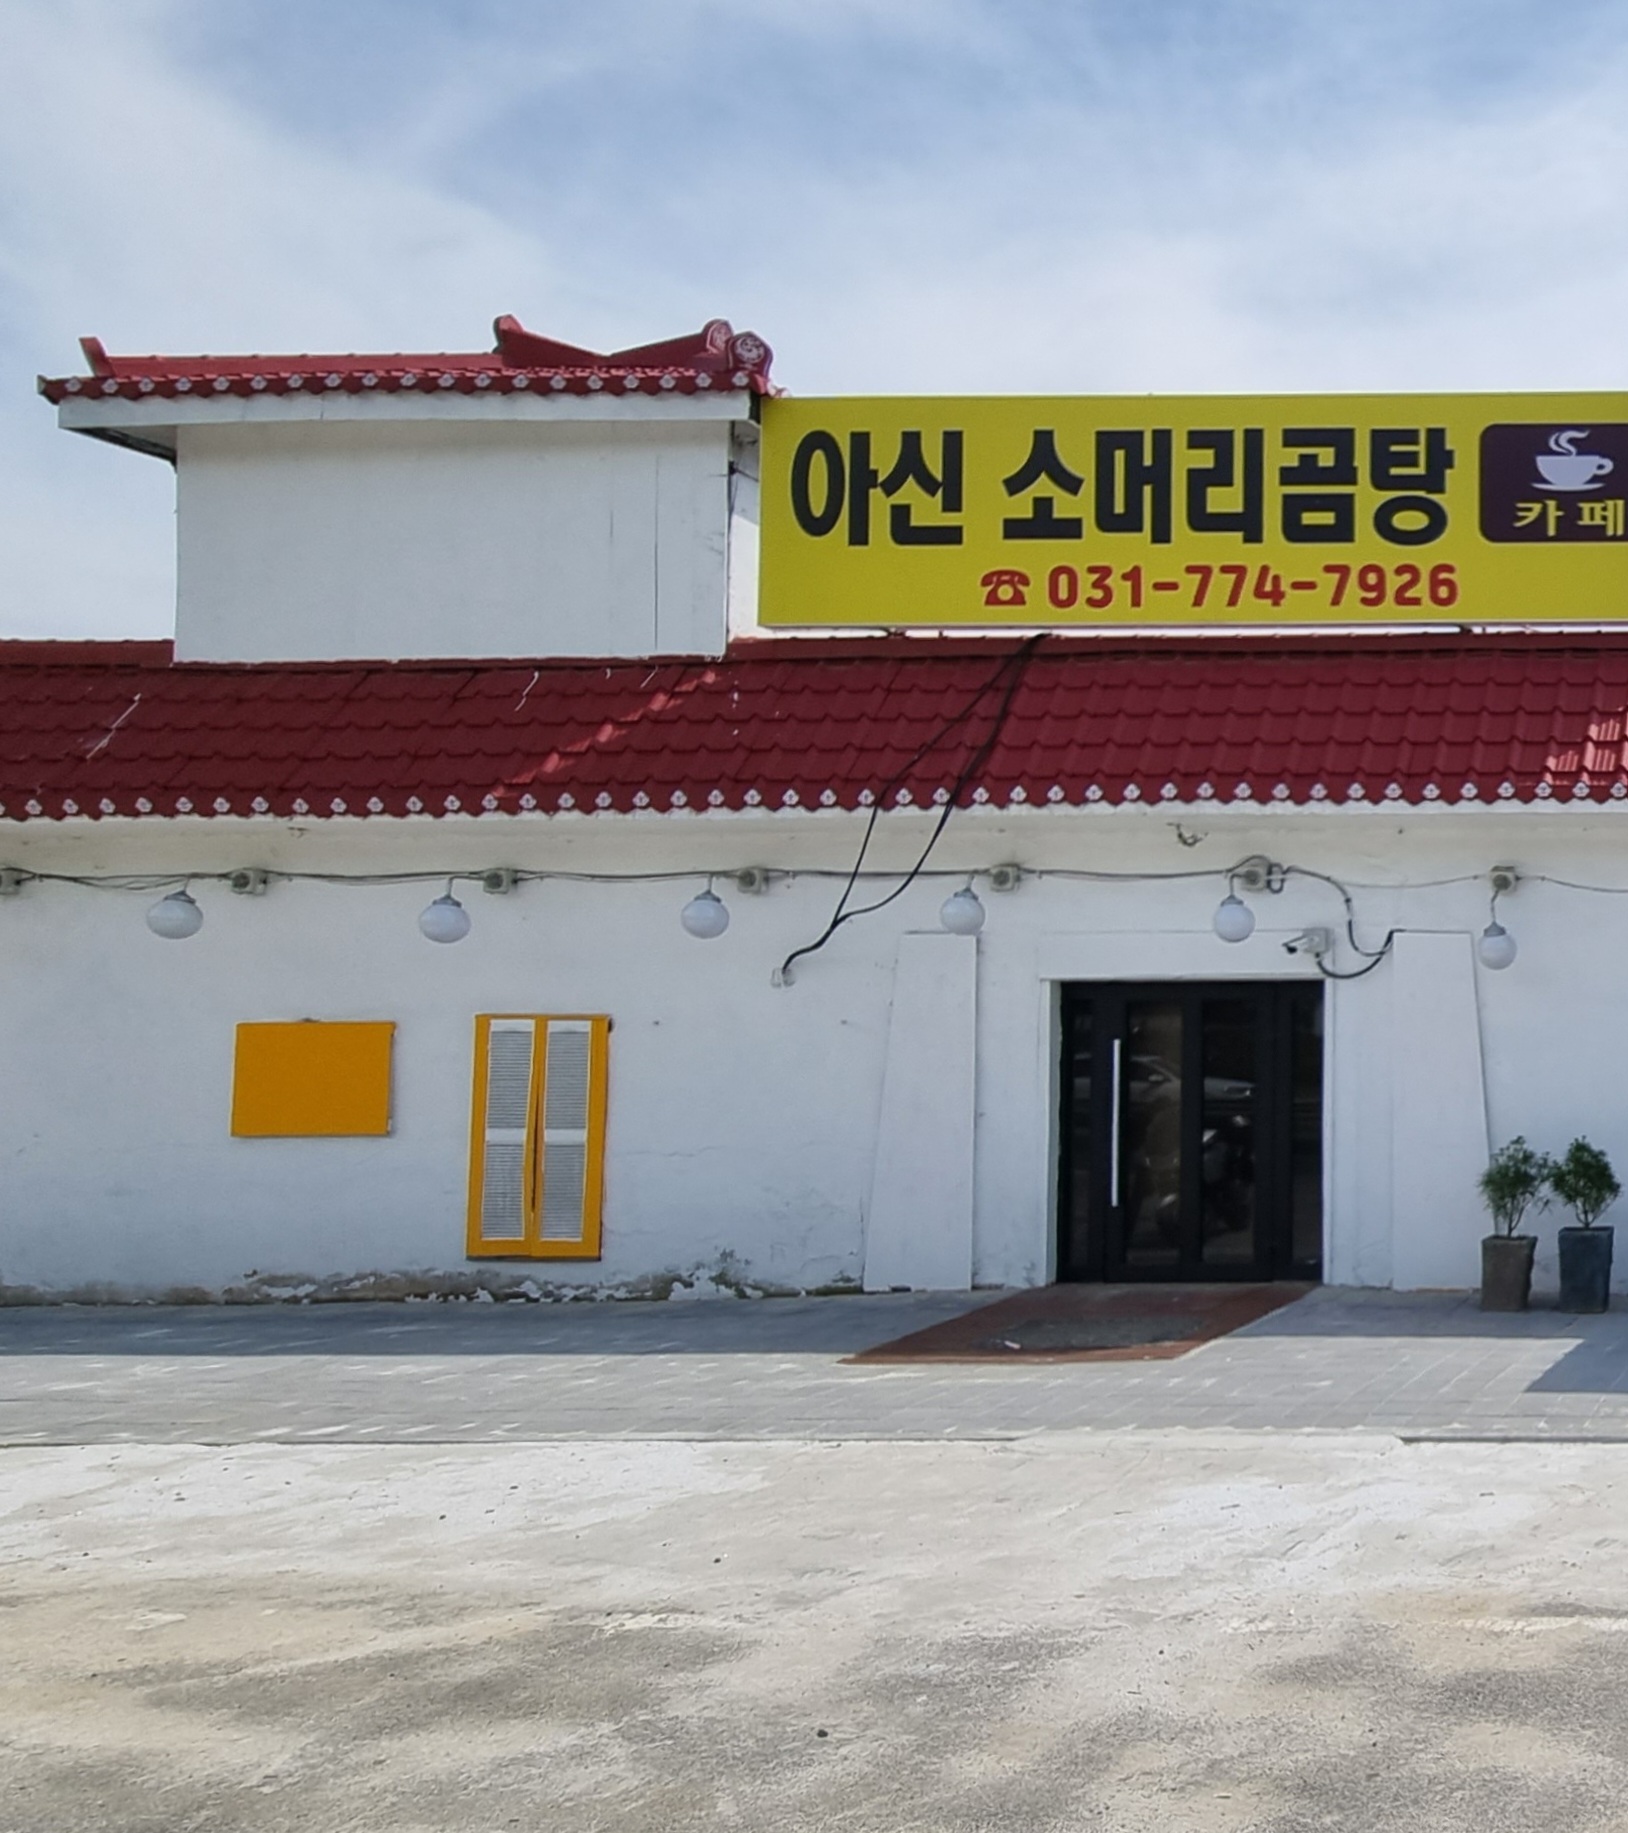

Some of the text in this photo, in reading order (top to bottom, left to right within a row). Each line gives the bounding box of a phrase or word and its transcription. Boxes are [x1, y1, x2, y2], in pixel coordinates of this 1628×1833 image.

[790, 427, 1455, 547] 아신 소머리곰탕
[1512, 499, 1628, 537] 카페
[1048, 563, 1459, 609] 031-774-7926
